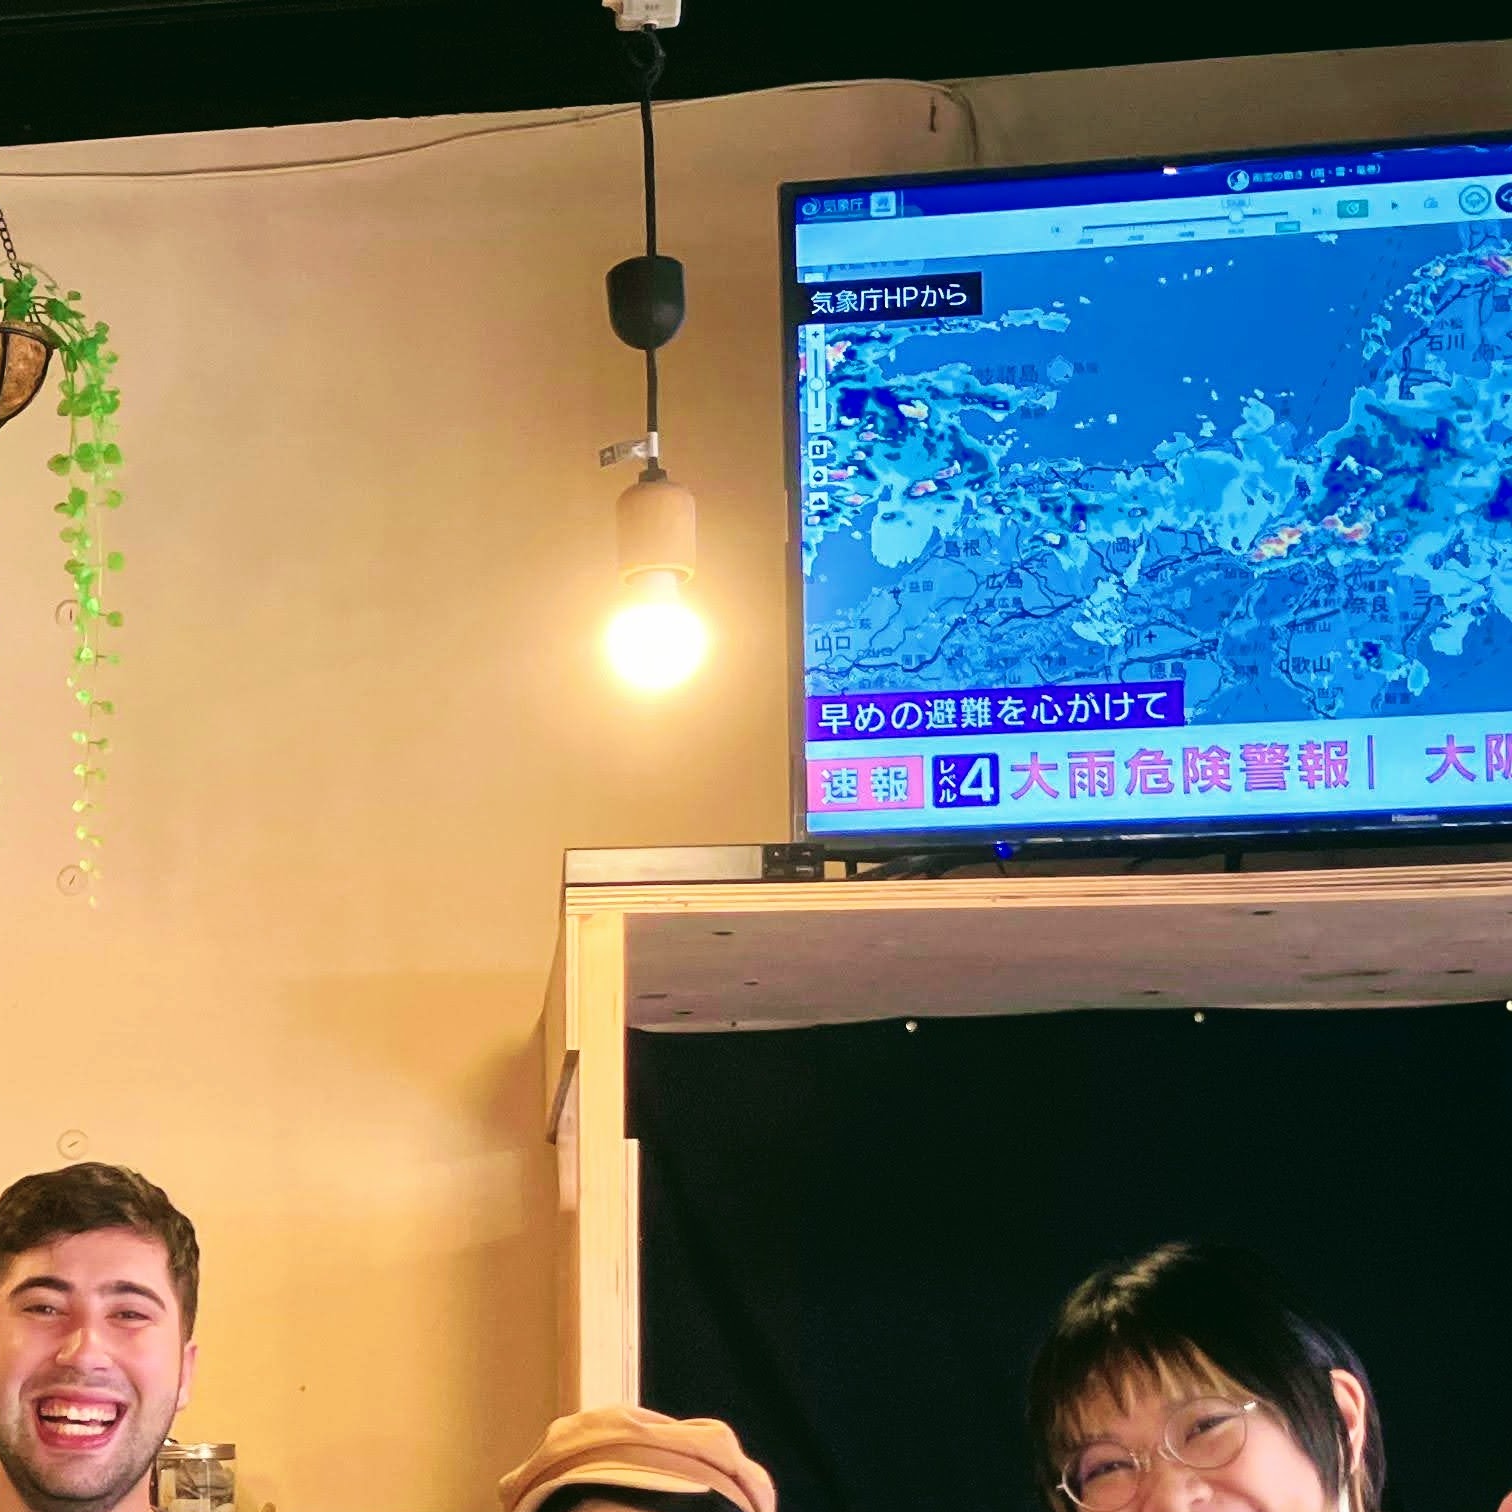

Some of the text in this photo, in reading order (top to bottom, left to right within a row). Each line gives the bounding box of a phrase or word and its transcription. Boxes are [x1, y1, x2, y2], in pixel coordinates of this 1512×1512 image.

[810, 283, 968, 315] 気象庁HPから
[1425, 333, 1465, 351] 石川
[814, 633, 851, 653] 山口
[817, 690, 1169, 735] 早めの避難を心がけて
[820, 764, 909, 805] 速報
[938, 760, 957, 804] レベル
[959, 757, 995, 803] 4
[1010, 740, 1350, 800] 大雨危険警報
